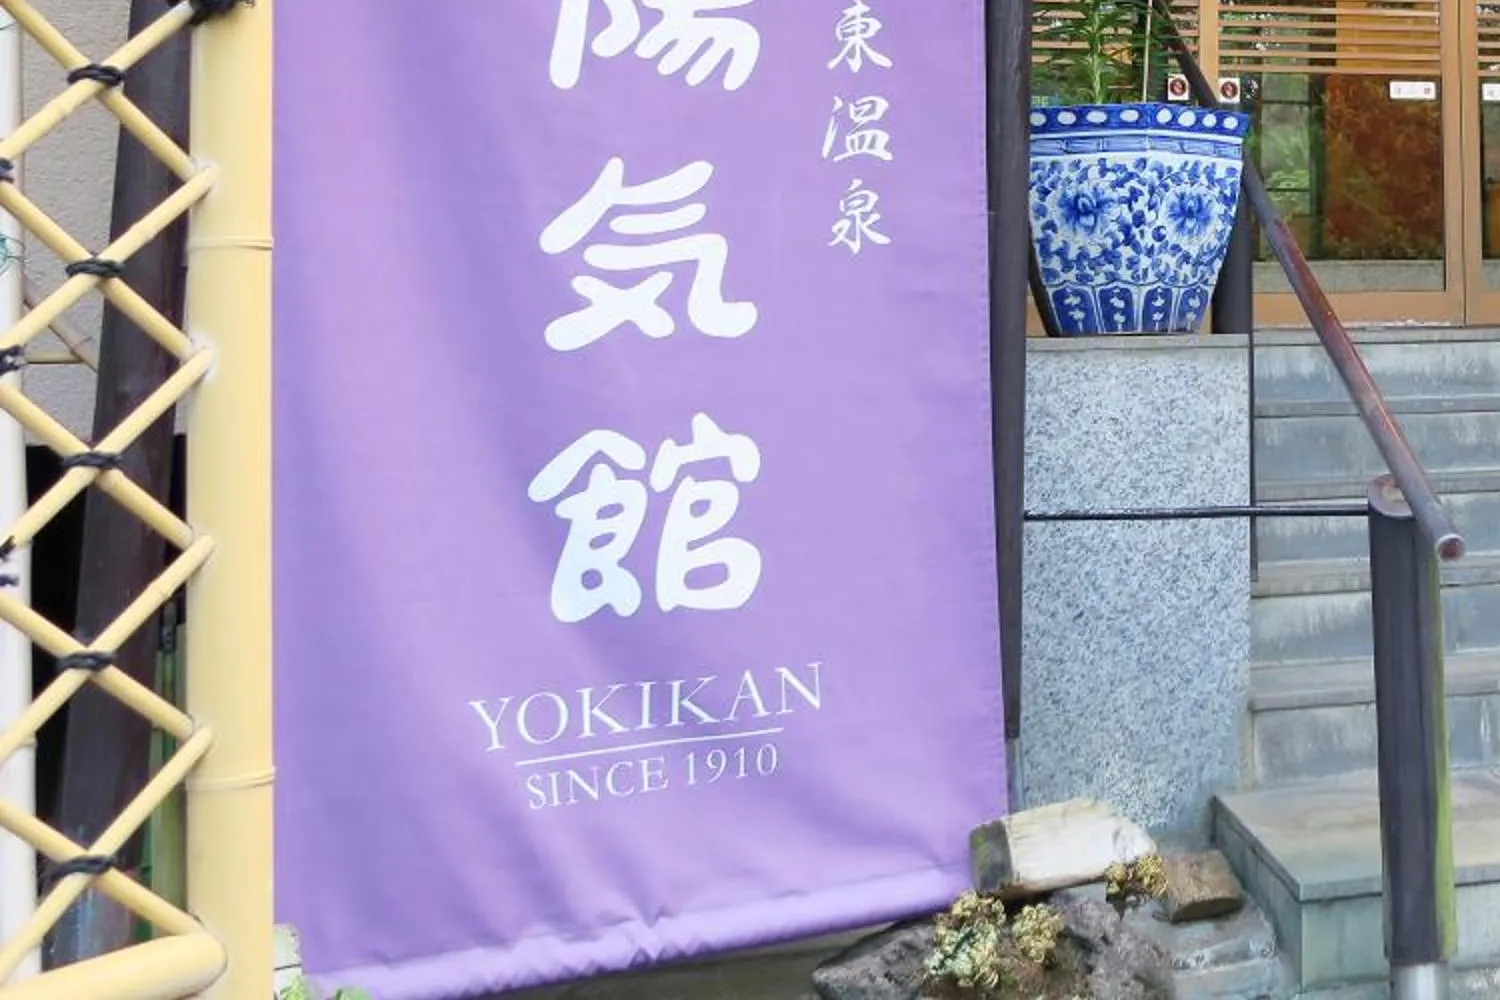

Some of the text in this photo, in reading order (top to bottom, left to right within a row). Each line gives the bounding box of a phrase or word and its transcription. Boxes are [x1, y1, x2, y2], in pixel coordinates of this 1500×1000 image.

[468, 662, 823, 752] YOKIKAN
[526, 743, 779, 810] SINCE 1910
